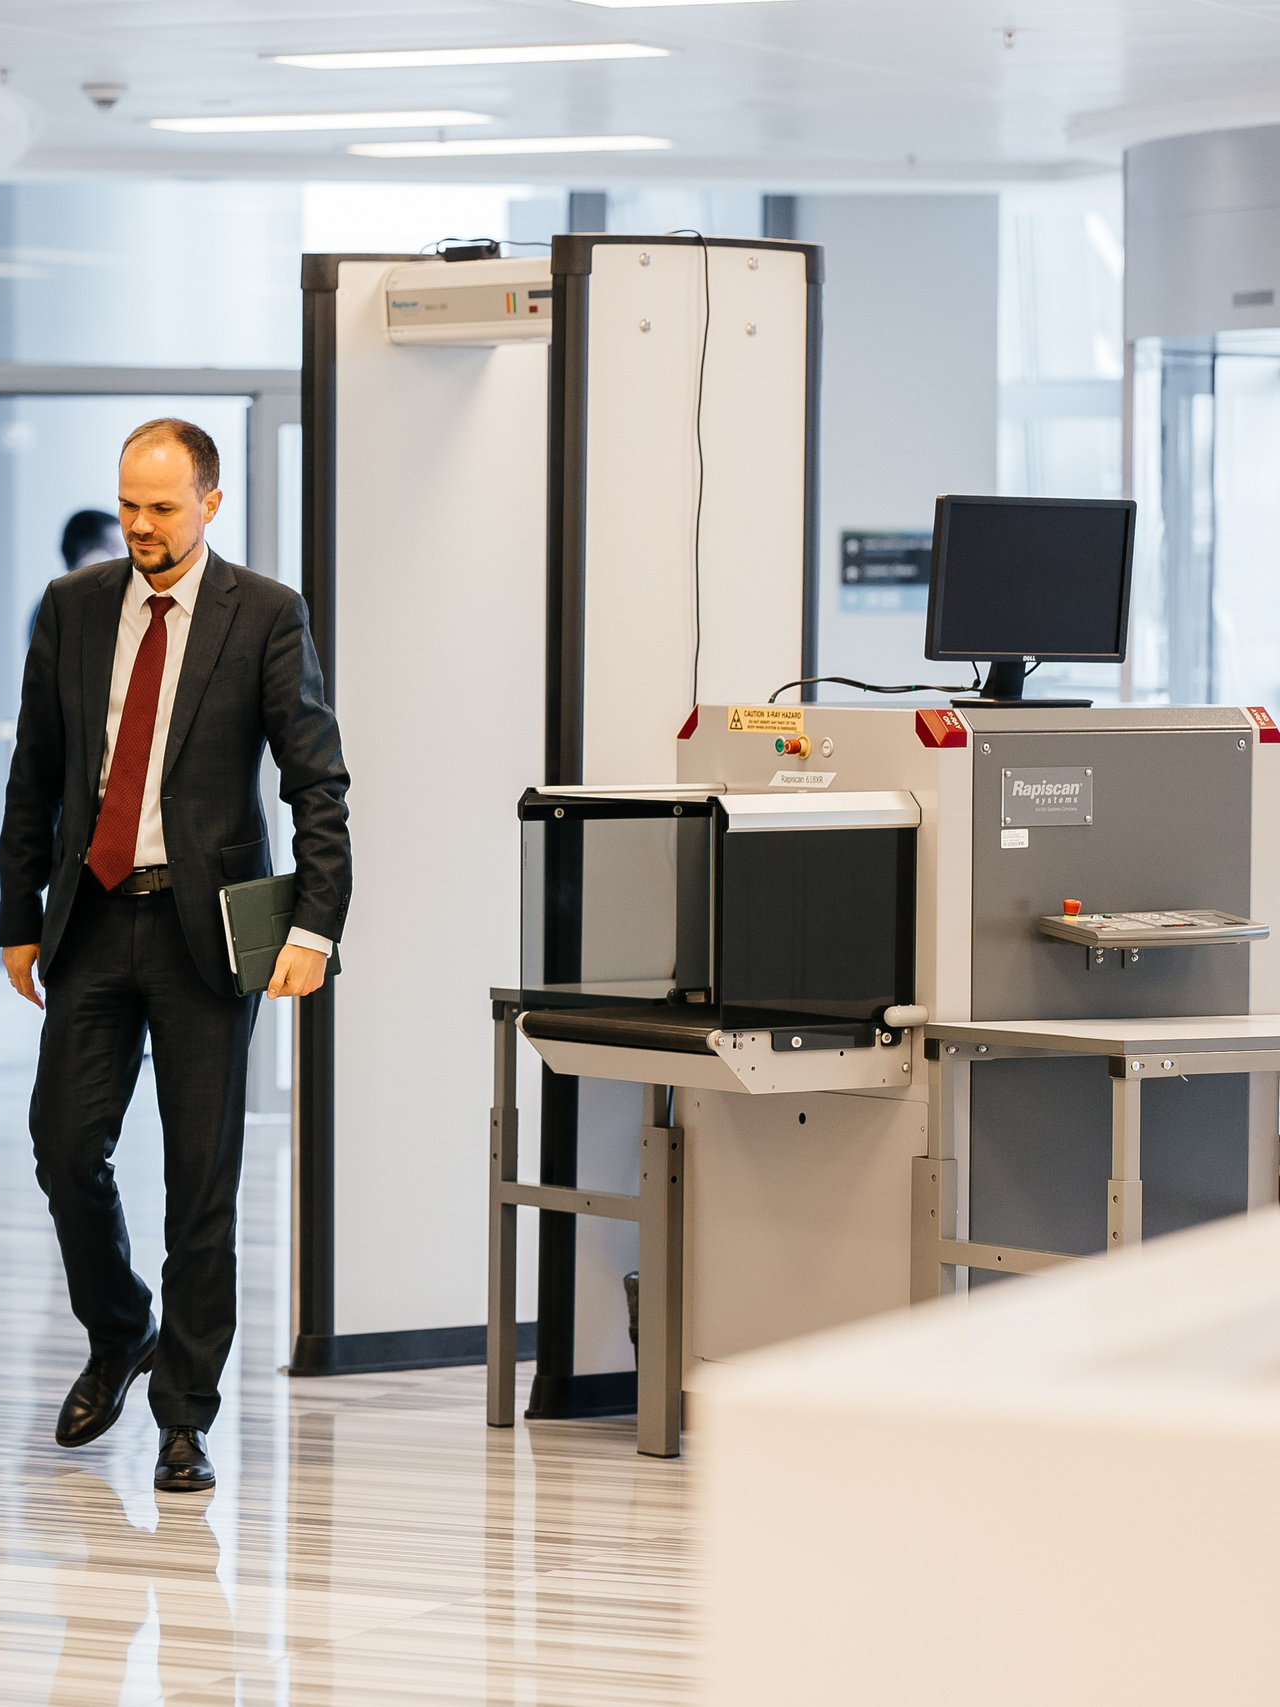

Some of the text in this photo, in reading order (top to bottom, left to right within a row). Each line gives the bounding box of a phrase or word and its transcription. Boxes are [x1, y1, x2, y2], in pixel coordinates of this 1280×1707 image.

[744, 710, 801, 719] CAUTION X-RAY HAZARD
[942, 715, 952, 725] ON
[946, 711, 962, 730] X-RAY
[781, 775, 805, 784] Rapiscan
[1012, 780, 1080, 799] Rapiscan
[1035, 796, 1078, 805] systems
